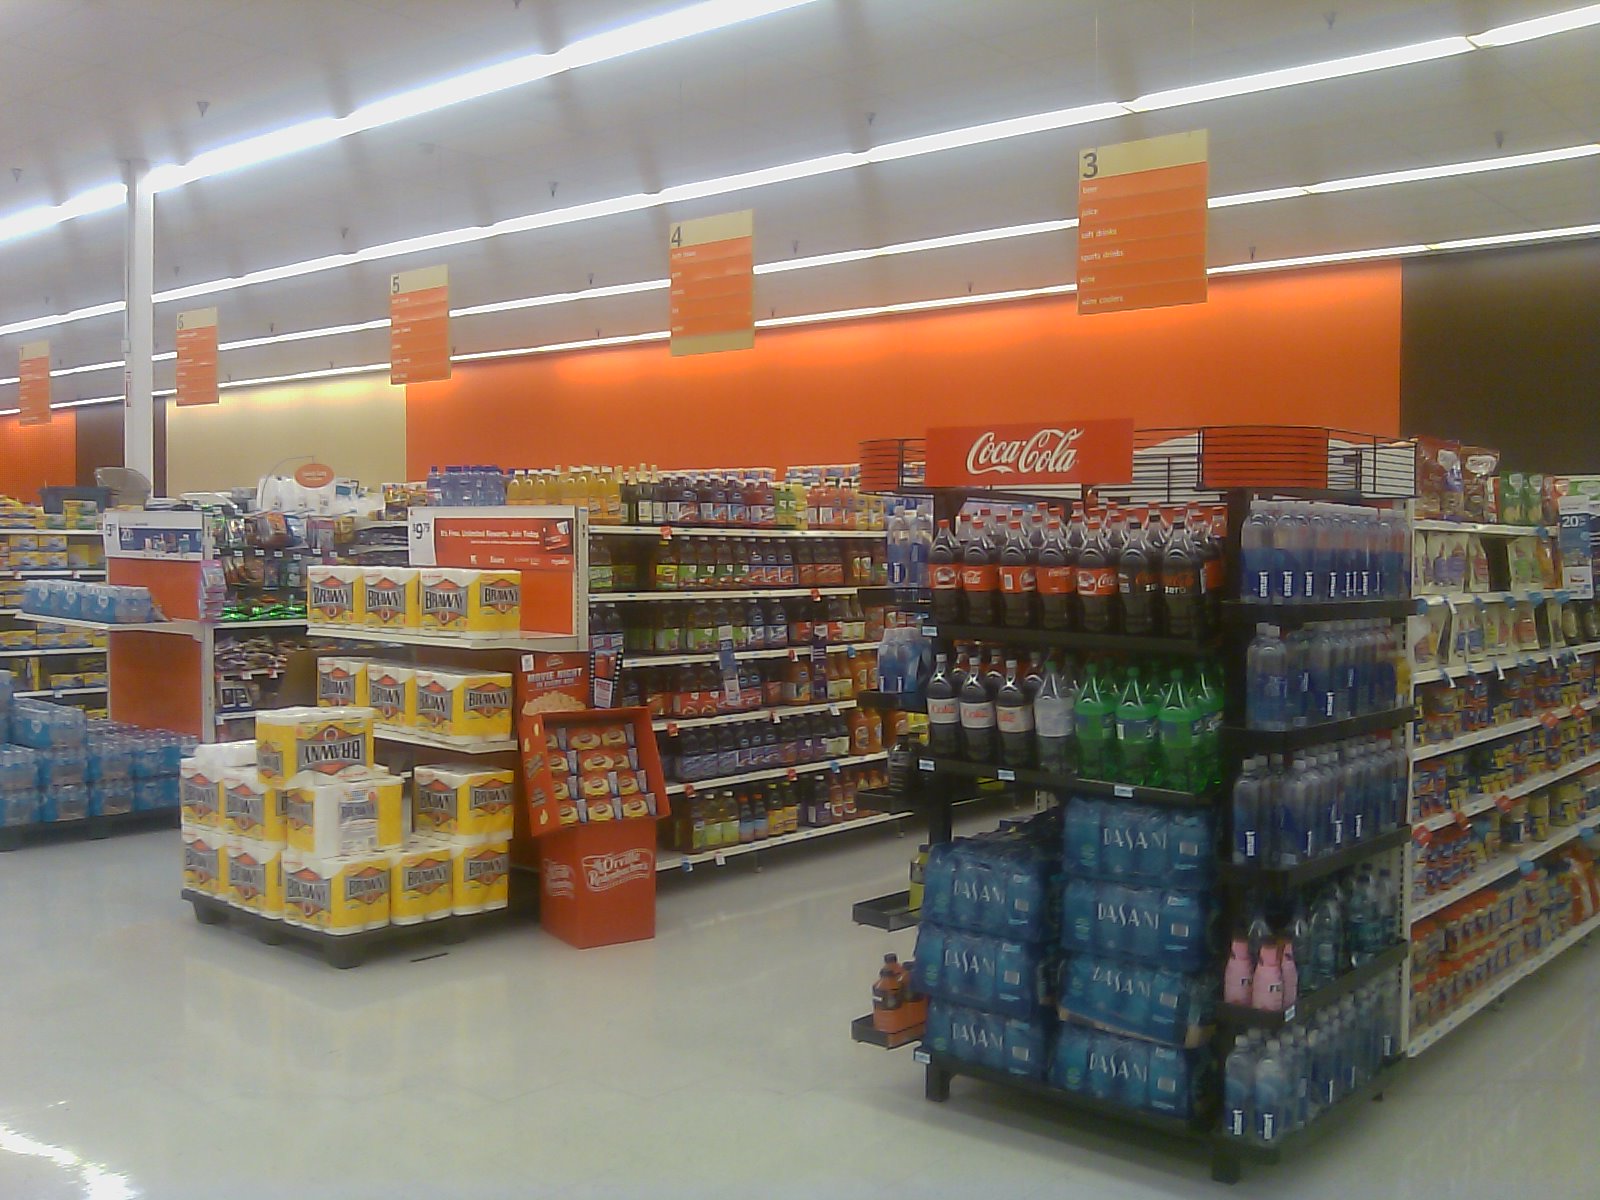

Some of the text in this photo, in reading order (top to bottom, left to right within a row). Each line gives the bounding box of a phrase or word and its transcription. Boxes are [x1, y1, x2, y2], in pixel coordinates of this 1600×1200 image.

[1082, 152, 1099, 179] 3
[671, 226, 682, 247] 4
[392, 275, 400, 294] 5
[966, 427, 1085, 475] Coca-Cola
[368, 590, 400, 608] BRAWNY
[425, 591, 464, 610] BRAWNY
[485, 587, 519, 604] BRAWNY
[469, 691, 508, 707] BRAWNY
[305, 740, 361, 763] BRAWNY
[1103, 827, 1168, 850] DASANI
[953, 879, 1005, 905] DASANI
[1097, 903, 1160, 930] DASANI
[952, 1023, 1004, 1049] DASANI
[1090, 1053, 1148, 1082] DASANI
